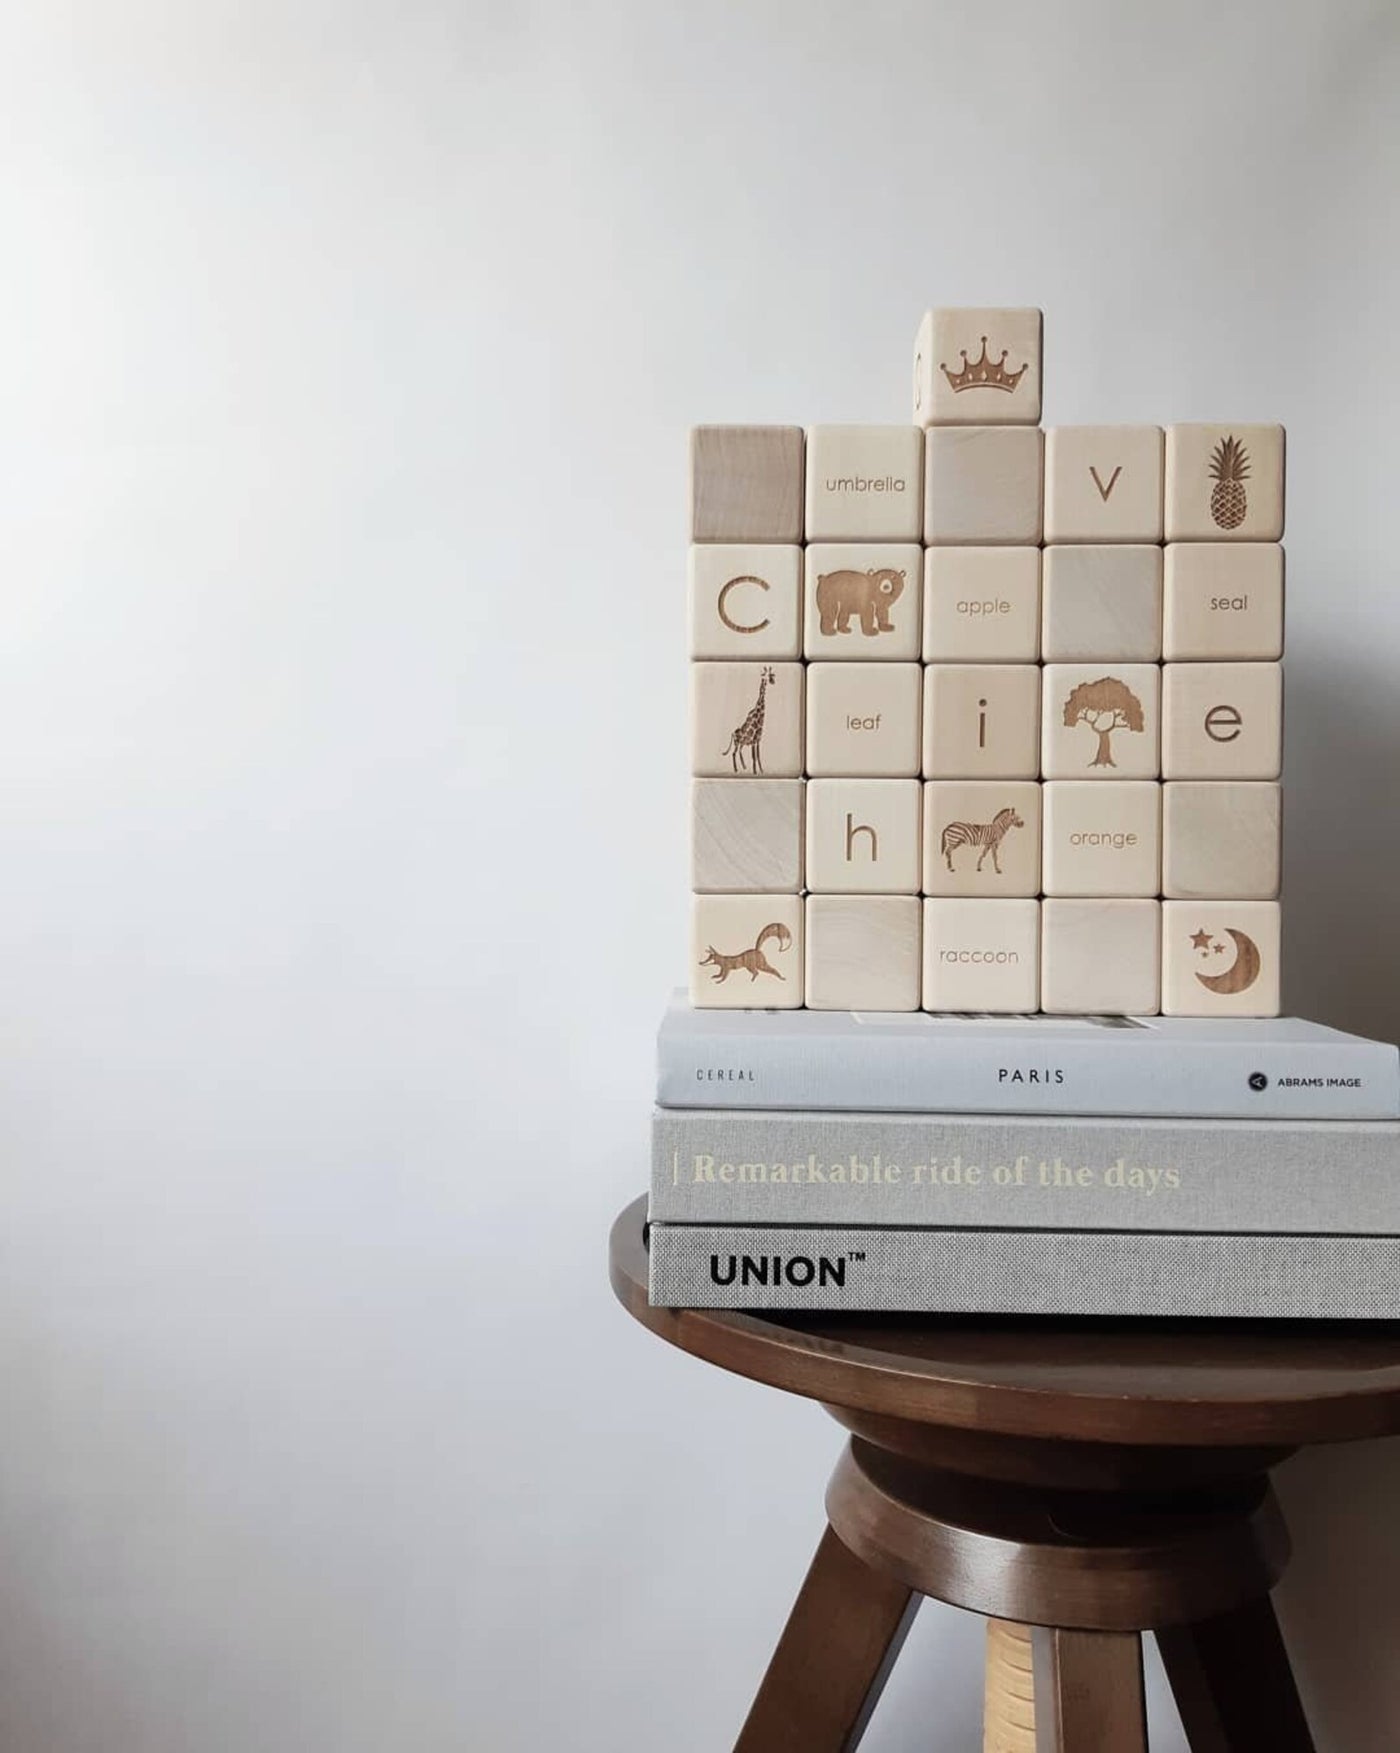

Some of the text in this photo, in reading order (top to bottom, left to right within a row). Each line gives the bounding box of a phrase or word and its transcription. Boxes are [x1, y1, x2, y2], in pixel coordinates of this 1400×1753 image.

[825, 476, 906, 492] umbrella
[956, 597, 1011, 617] apple
[1210, 594, 1248, 611] seal
[846, 714, 882, 731] leaf
[977, 698, 989, 748] i
[1204, 704, 1243, 743] e
[846, 813, 878, 862] h
[1069, 832, 1138, 850] orange
[939, 949, 1019, 964] raccoon
[696, 1069, 756, 1082] CEREAL
[998, 1067, 1065, 1084] PARIS
[1277, 1077, 1362, 1088] ABRAMS IMAGE
[692, 1153, 1181, 1197] Remarkable ride of the days
